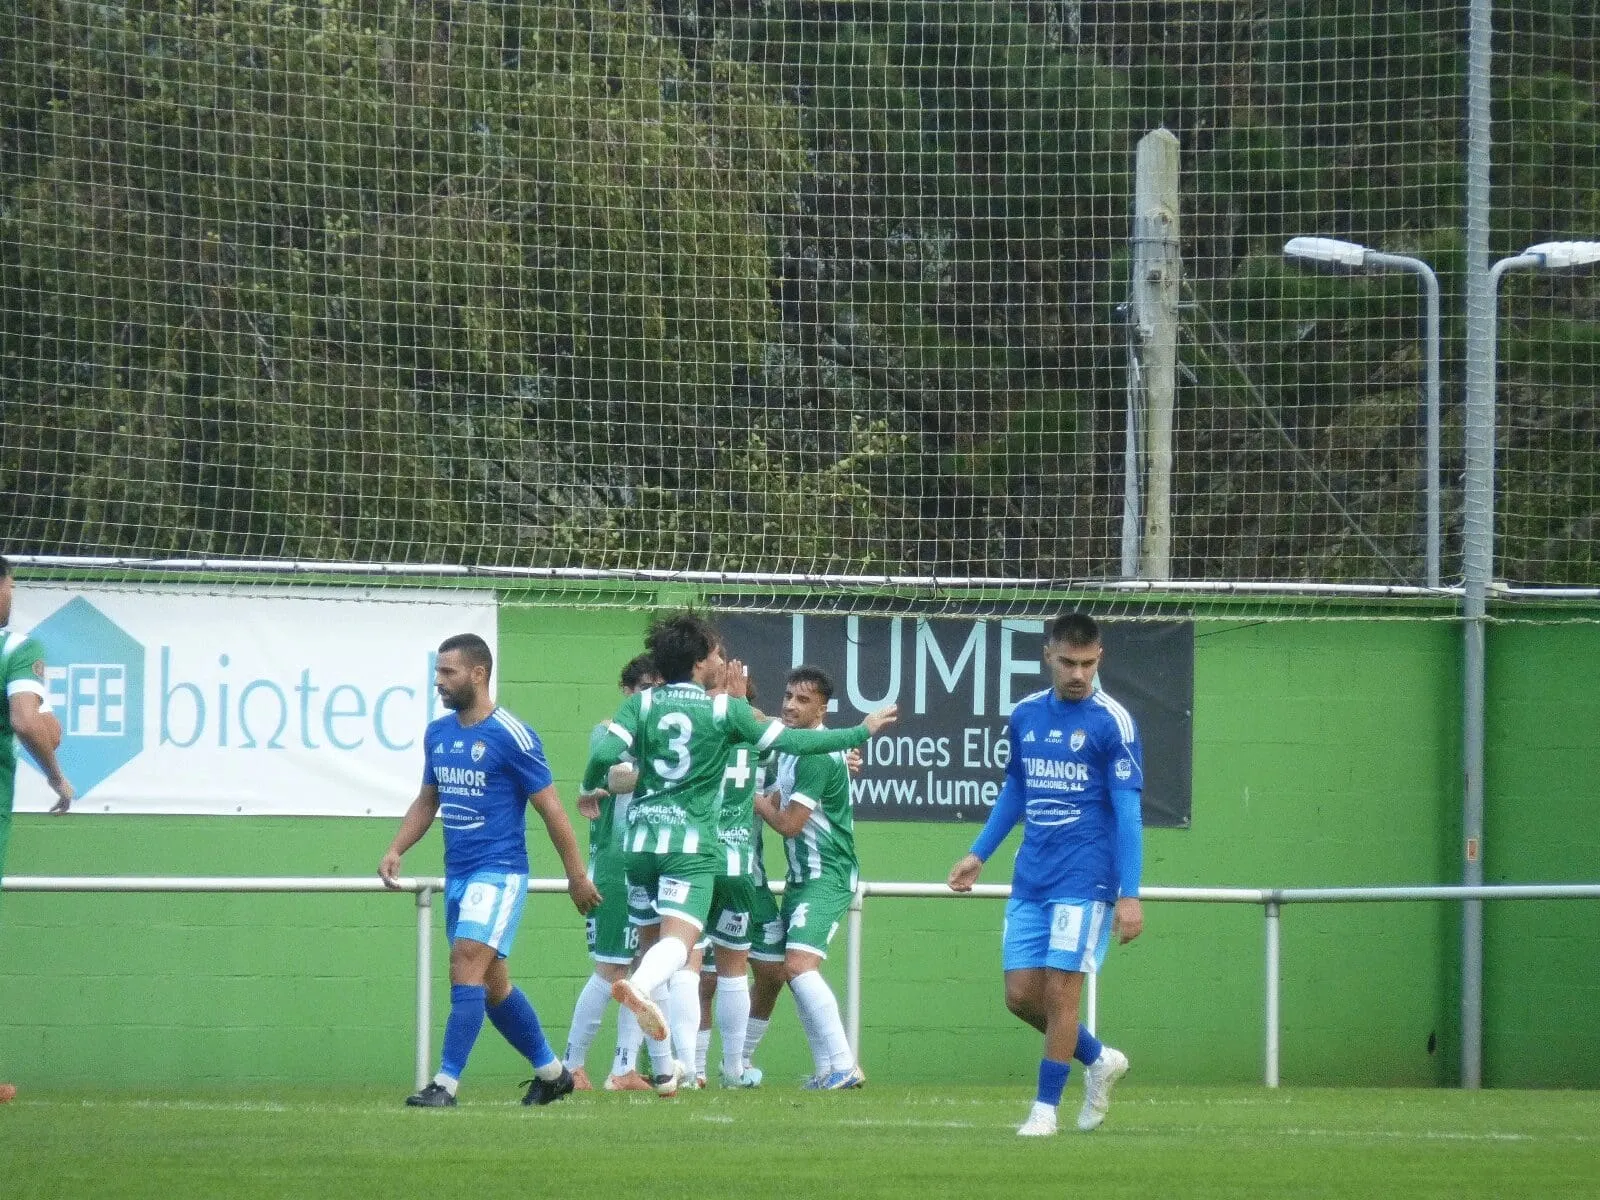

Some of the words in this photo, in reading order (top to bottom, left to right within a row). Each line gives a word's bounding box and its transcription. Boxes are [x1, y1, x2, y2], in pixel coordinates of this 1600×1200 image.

[792, 614, 1102, 716] LUME
[653, 712, 692, 779] 3
[867, 736, 950, 767] iones
[963, 725, 1012, 769] Elé
[433, 766, 486, 787] UBANOR
[849, 771, 1006, 806] www.lume
[624, 927, 640, 949] 18
